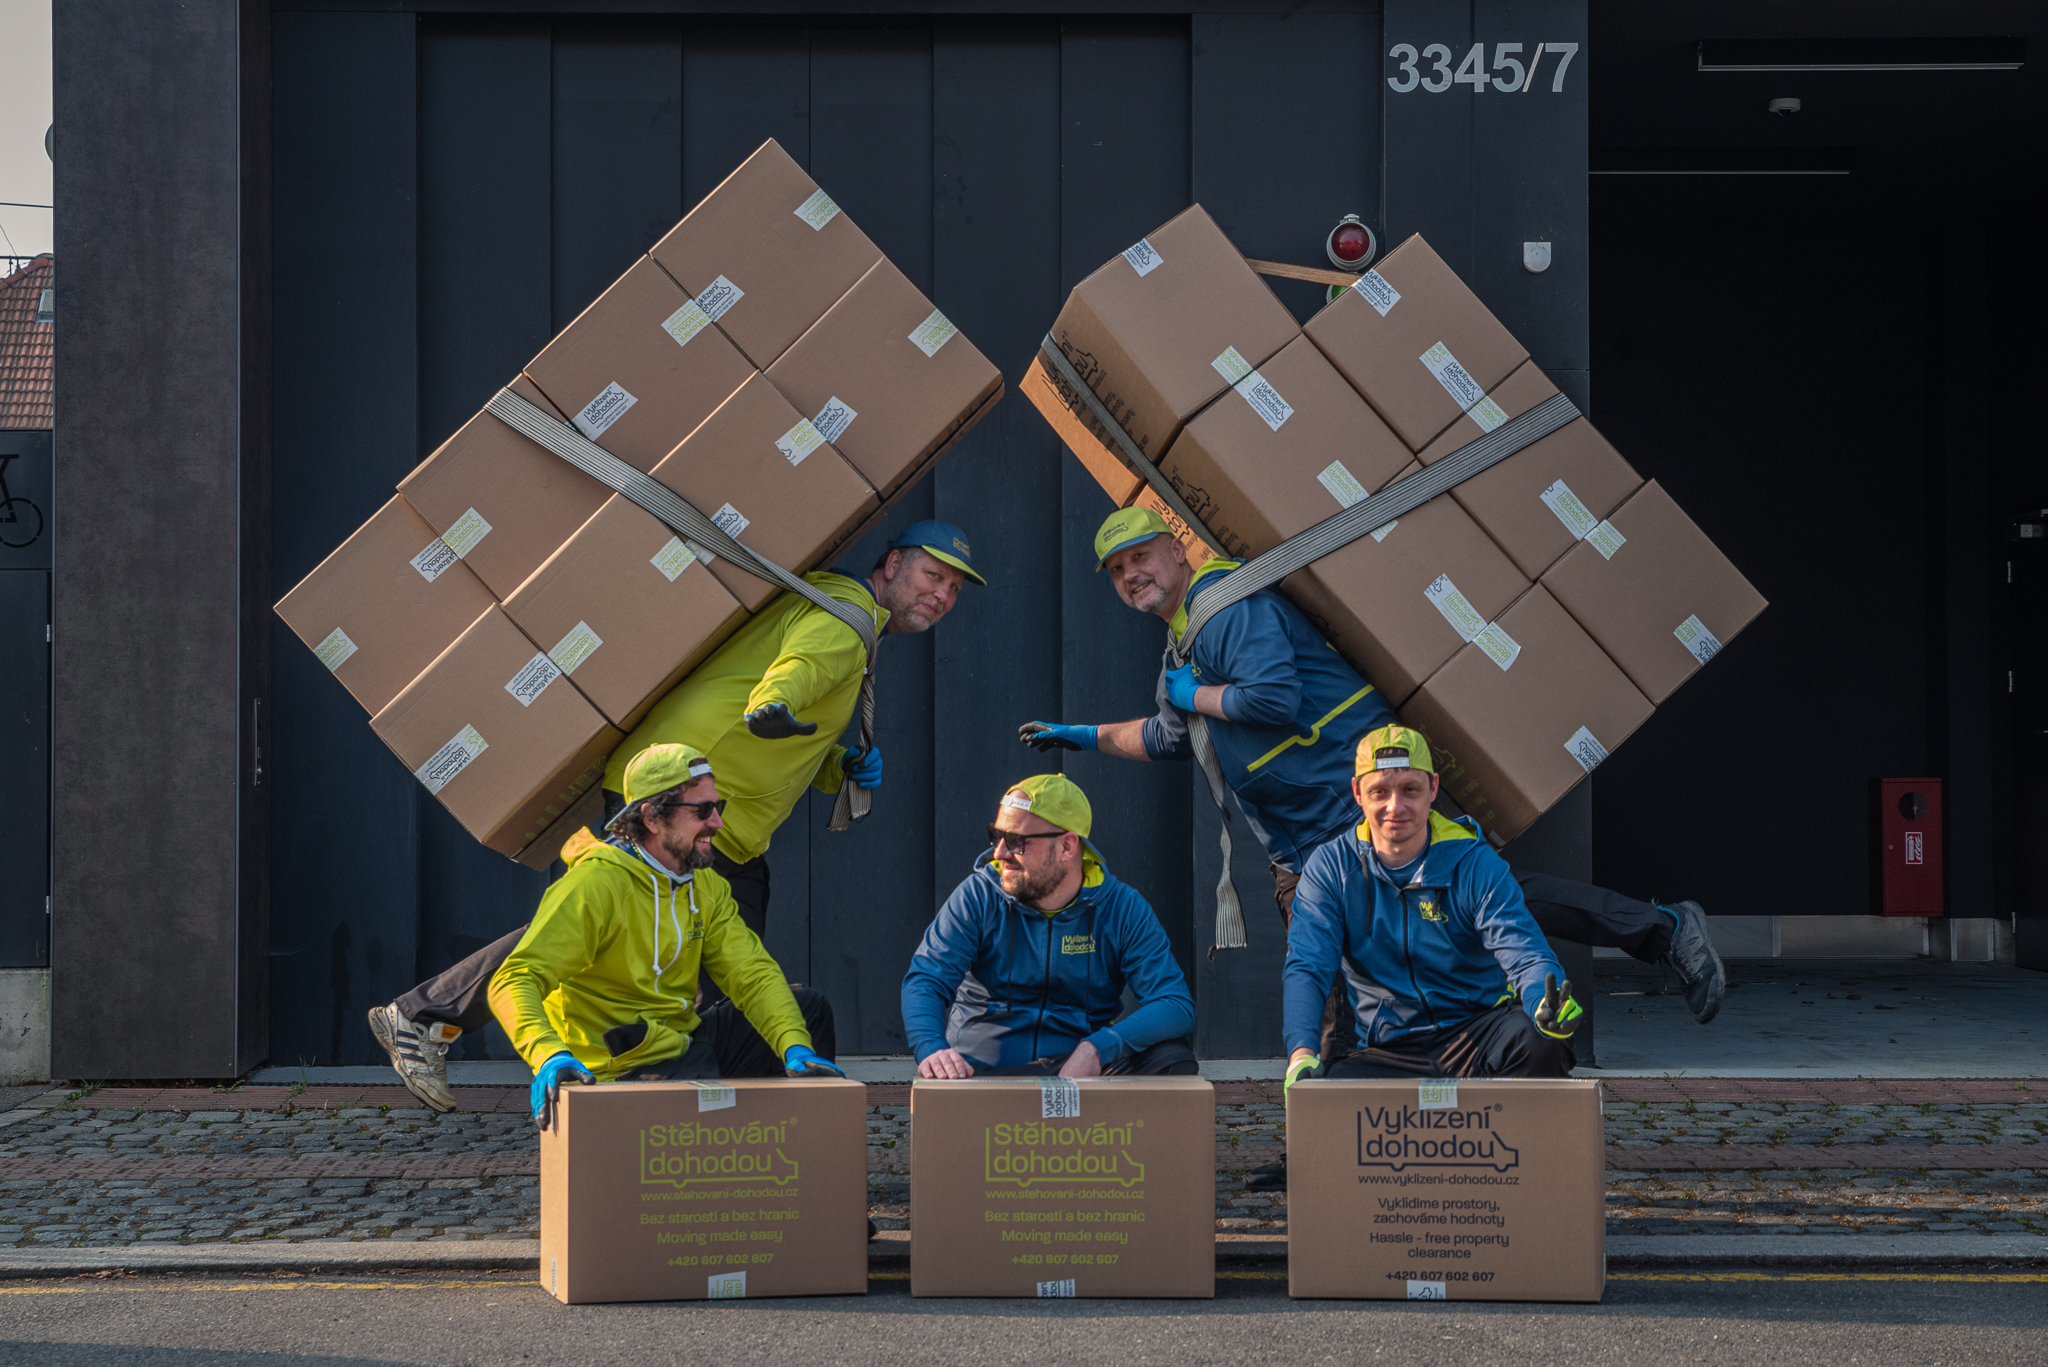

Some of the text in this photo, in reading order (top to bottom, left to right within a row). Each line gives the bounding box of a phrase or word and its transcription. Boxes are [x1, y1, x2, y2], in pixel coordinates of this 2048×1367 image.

[1387, 42, 1579, 93] 3345/7
[649, 1120, 787, 1147] Stěhování
[994, 1121, 1134, 1145] Stěhování
[1366, 1134, 1494, 1158] dohodou
[649, 1149, 771, 1175] dohodou
[993, 1149, 1117, 1173] dohodou
[1358, 1173, 1519, 1187] www.vyklizeni-dohodou.cz
[641, 1187, 799, 1201] www.stehovani-dohodou.cz
[986, 1188, 1144, 1199] www.stehovani-dohodou.cz
[1442, 1199, 1500, 1213] prostory,
[640, 1212, 665, 1225] Bez
[720, 1212, 729, 1222] a
[732, 1209, 756, 1222] bez
[759, 1208, 799, 1221] hranic
[985, 1210, 1009, 1222] Bez
[1065, 1212, 1074, 1222] a
[1077, 1210, 1101, 1222] bez
[1104, 1209, 1146, 1222] hranic
[1373, 1212, 1505, 1228] zachováme hodnoty
[657, 1229, 783, 1246] Moving made easy
[1001, 1229, 1128, 1245] Moving made easy
[1370, 1231, 1413, 1243] Hassle
[1425, 1232, 1450, 1244] free
[1453, 1234, 1509, 1248] property
[667, 1253, 774, 1266] +420 607 602 607
[1011, 1254, 1119, 1264] +420 607 602 607
[1408, 1246, 1471, 1259] clearance
[1385, 1271, 1495, 1282] +420 607 602 607
